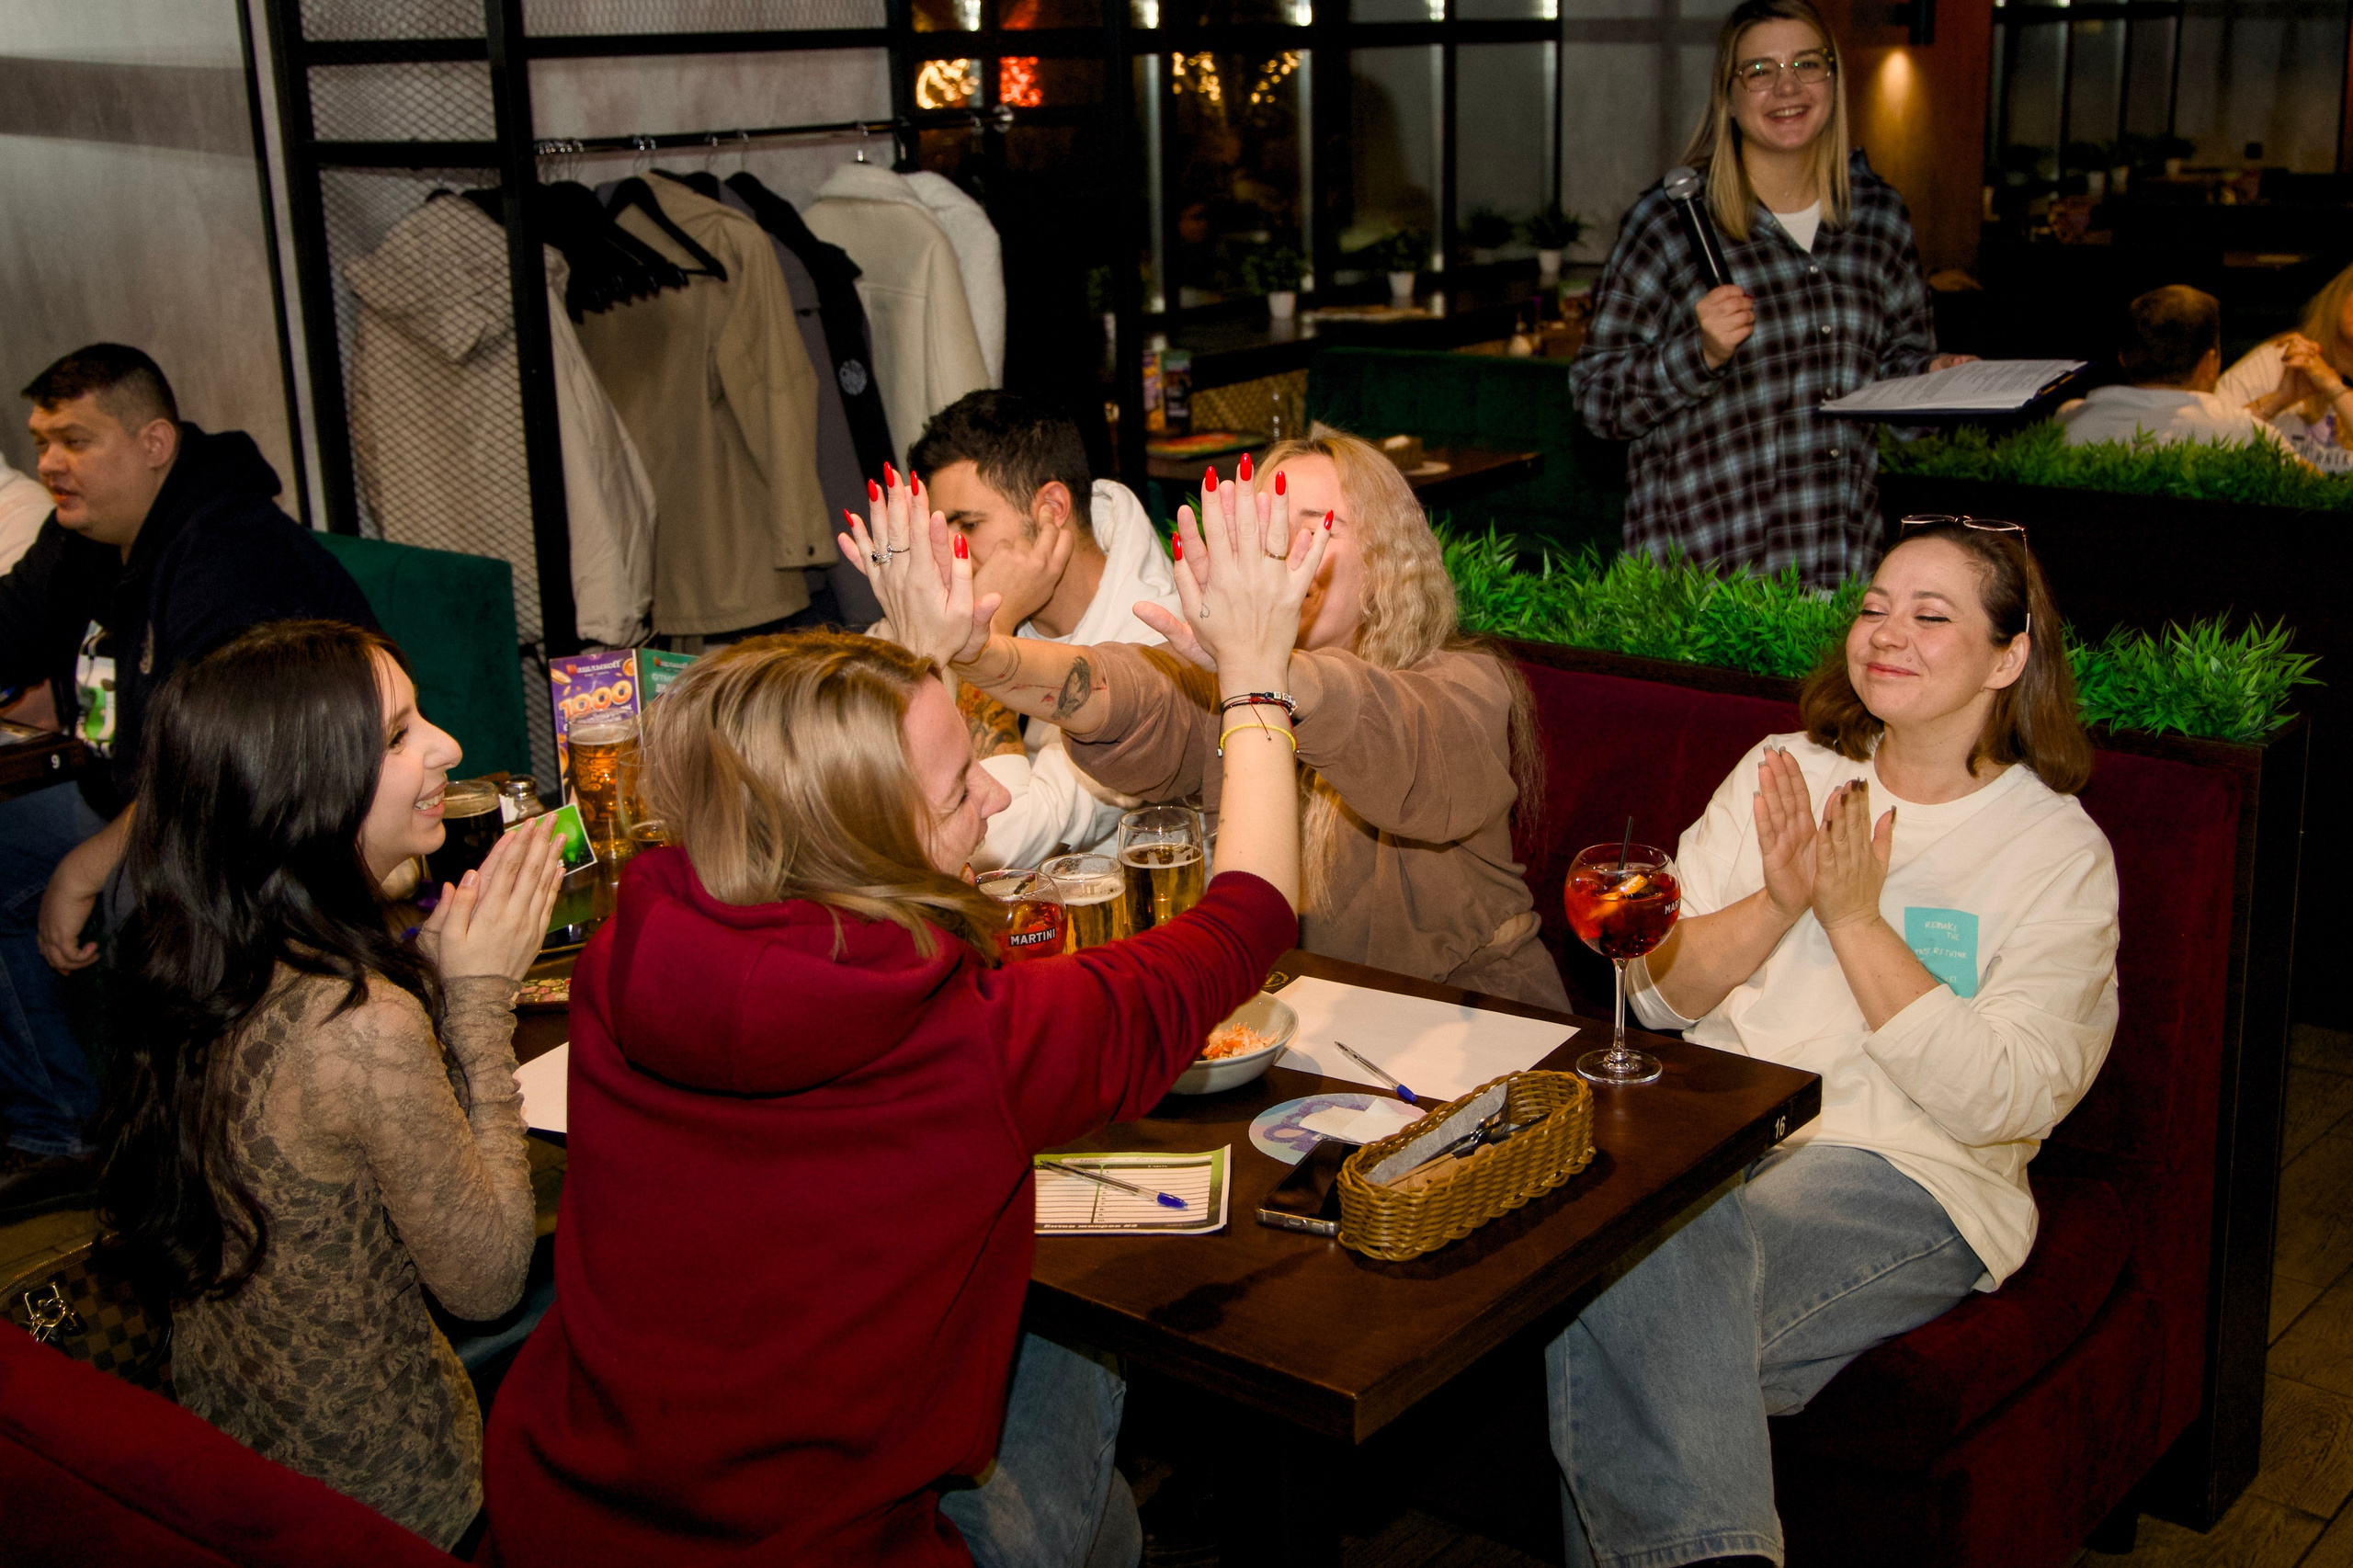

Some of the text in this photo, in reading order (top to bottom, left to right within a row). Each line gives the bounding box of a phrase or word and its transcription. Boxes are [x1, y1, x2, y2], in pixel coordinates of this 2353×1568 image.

[559, 680, 632, 719] 1000
[51, 754, 61, 769] 9
[1925, 921, 1957, 931] REMAKE
[1010, 928, 1055, 946] MARTINI
[1948, 932, 1959, 940] THE
[1774, 1115, 1786, 1140] 16
